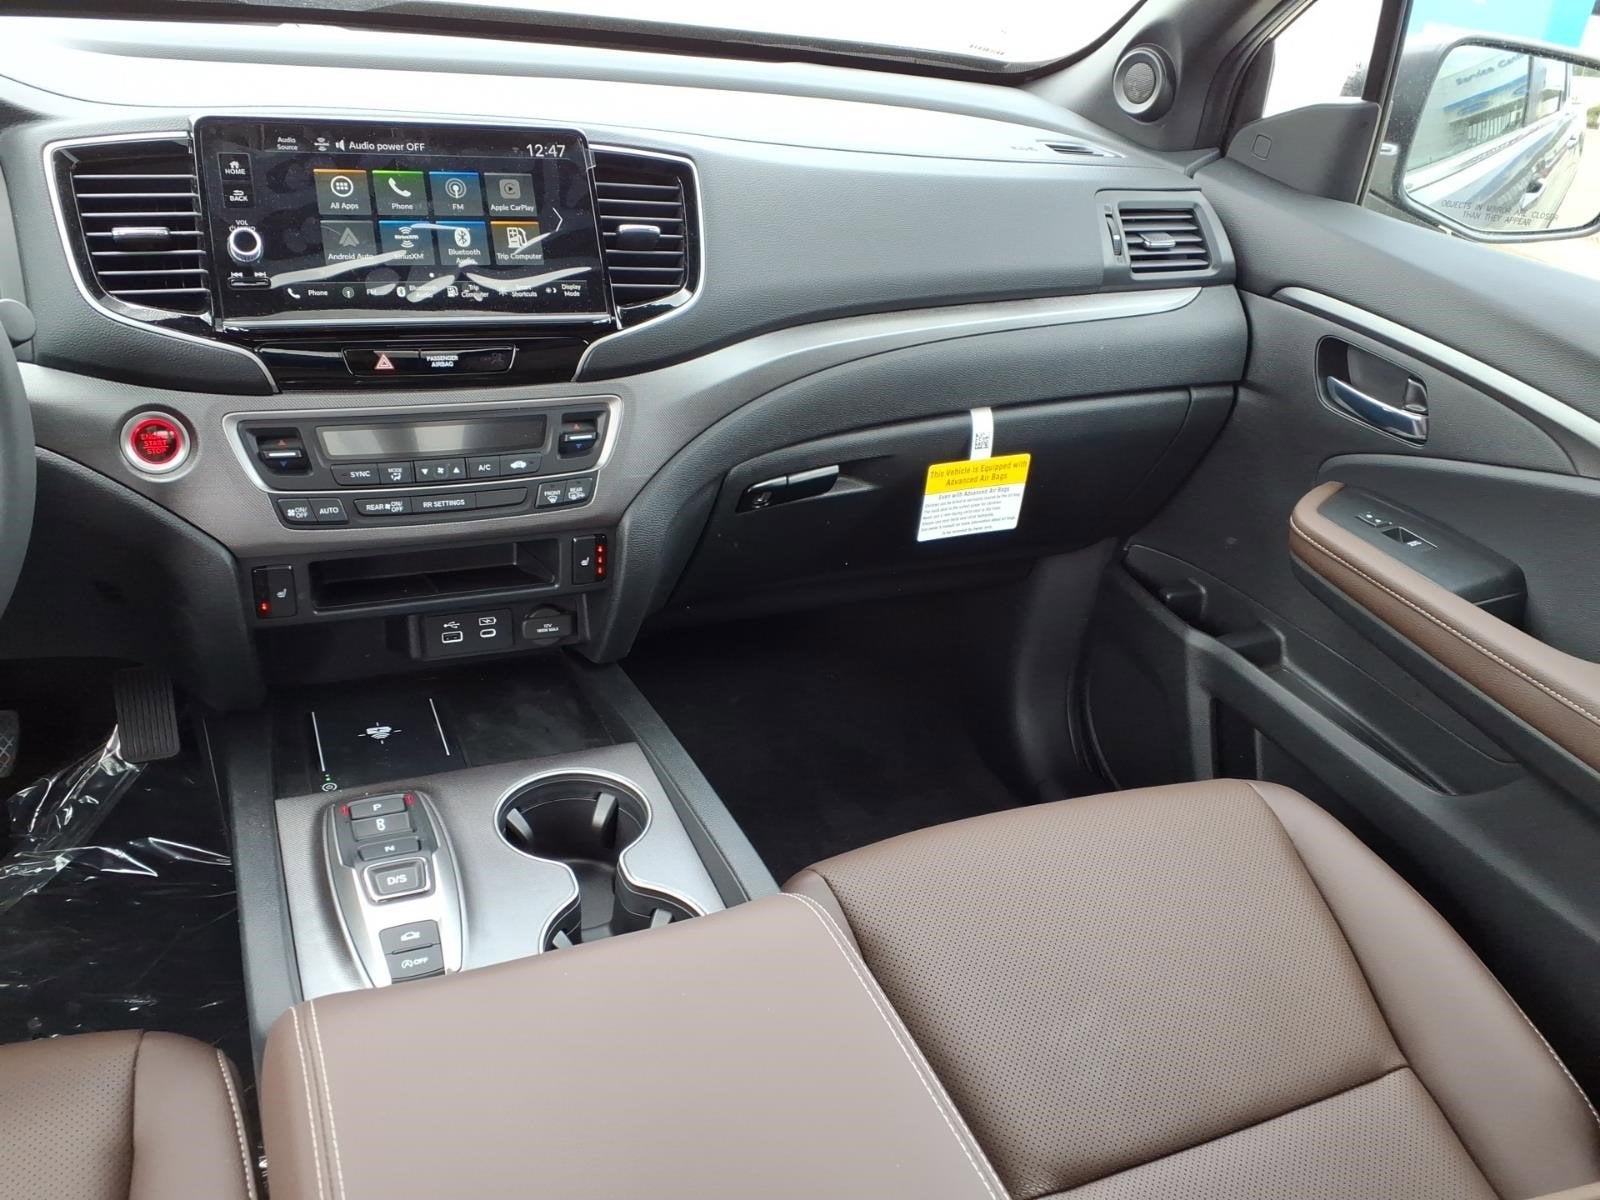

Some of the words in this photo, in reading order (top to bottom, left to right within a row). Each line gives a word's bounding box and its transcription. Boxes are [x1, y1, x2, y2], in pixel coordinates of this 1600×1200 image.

[277, 136, 296, 144] Audio
[349, 141, 375, 150] Audio
[377, 143, 404, 152] power
[406, 143, 425, 151] OFF
[526, 144, 566, 158] 12:47
[330, 202, 340, 210] All
[341, 203, 359, 211] Apps
[391, 203, 413, 211] Phone
[490, 204, 509, 212] Apple
[510, 205, 535, 213] CarPlay
[1441, 200, 1472, 209] OBJECTS
[1463, 211, 1481, 219] THAN
[1505, 215, 1532, 226] APPEAR
[448, 248, 481, 256] Bluetooth
[328, 253, 355, 261] Android
[510, 253, 542, 261] Computer
[478, 463, 491, 471] A/C
[930, 470, 944, 479] This
[946, 467, 971, 477] Vehicle
[980, 462, 1012, 473] Equipped
[350, 470, 371, 478] SYNC
[946, 476, 978, 486] Advanced
[981, 474, 989, 482] Air
[991, 473, 1008, 482] Bags
[544, 489, 561, 497] FRONT
[436, 499, 465, 508] SETTINGS
[319, 506, 339, 515] AUTO
[372, 803, 382, 811] P
[387, 874, 407, 885] D/S
[413, 957, 429, 966] OFF
